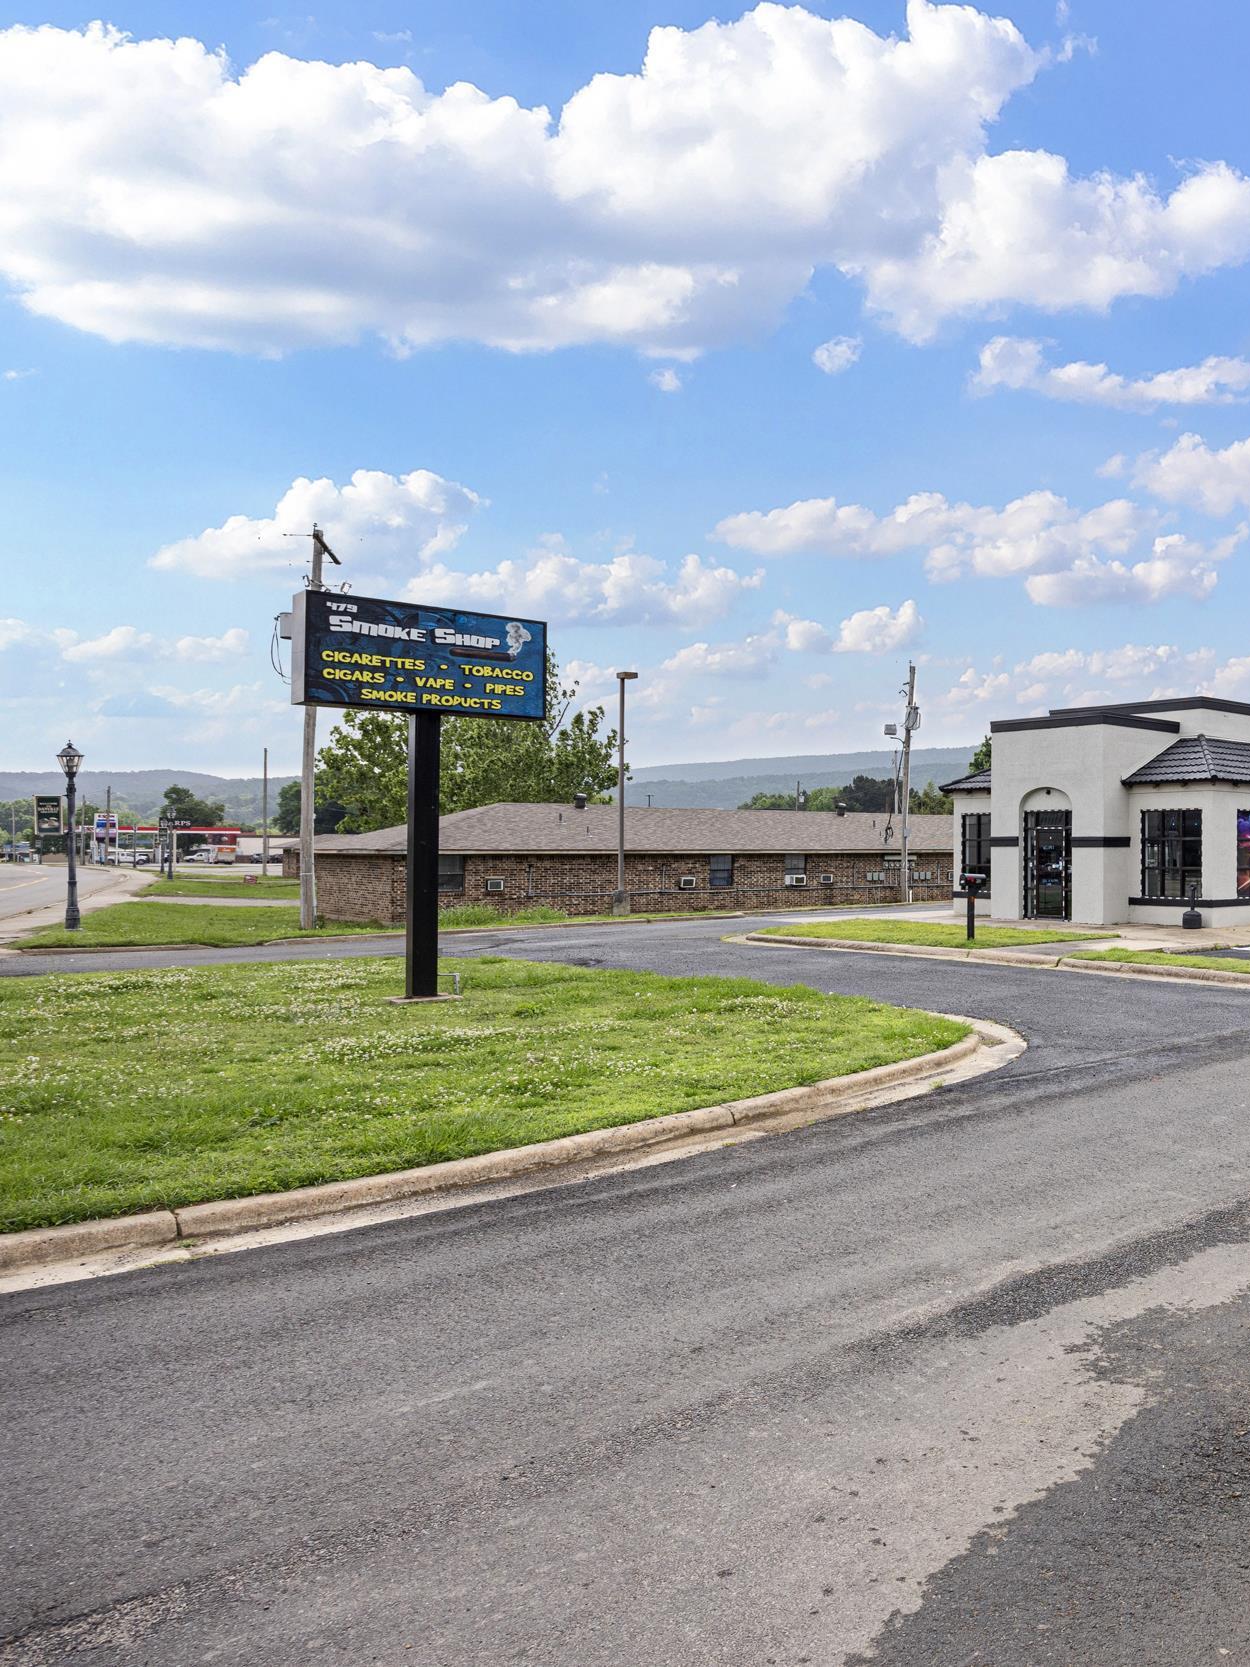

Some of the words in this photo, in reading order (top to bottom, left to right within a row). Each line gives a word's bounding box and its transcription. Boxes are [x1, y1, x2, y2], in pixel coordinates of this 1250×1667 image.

[326, 601, 358, 613] 479
[321, 650, 425, 670] CIGARETTES
[461, 665, 534, 681] TOBACCO
[322, 668, 385, 683] CIGARS
[415, 677, 454, 690] VAPE
[485, 683, 525, 696] PIPES
[361, 688, 416, 703] SMOKE
[422, 695, 502, 710] PRODUCTS
